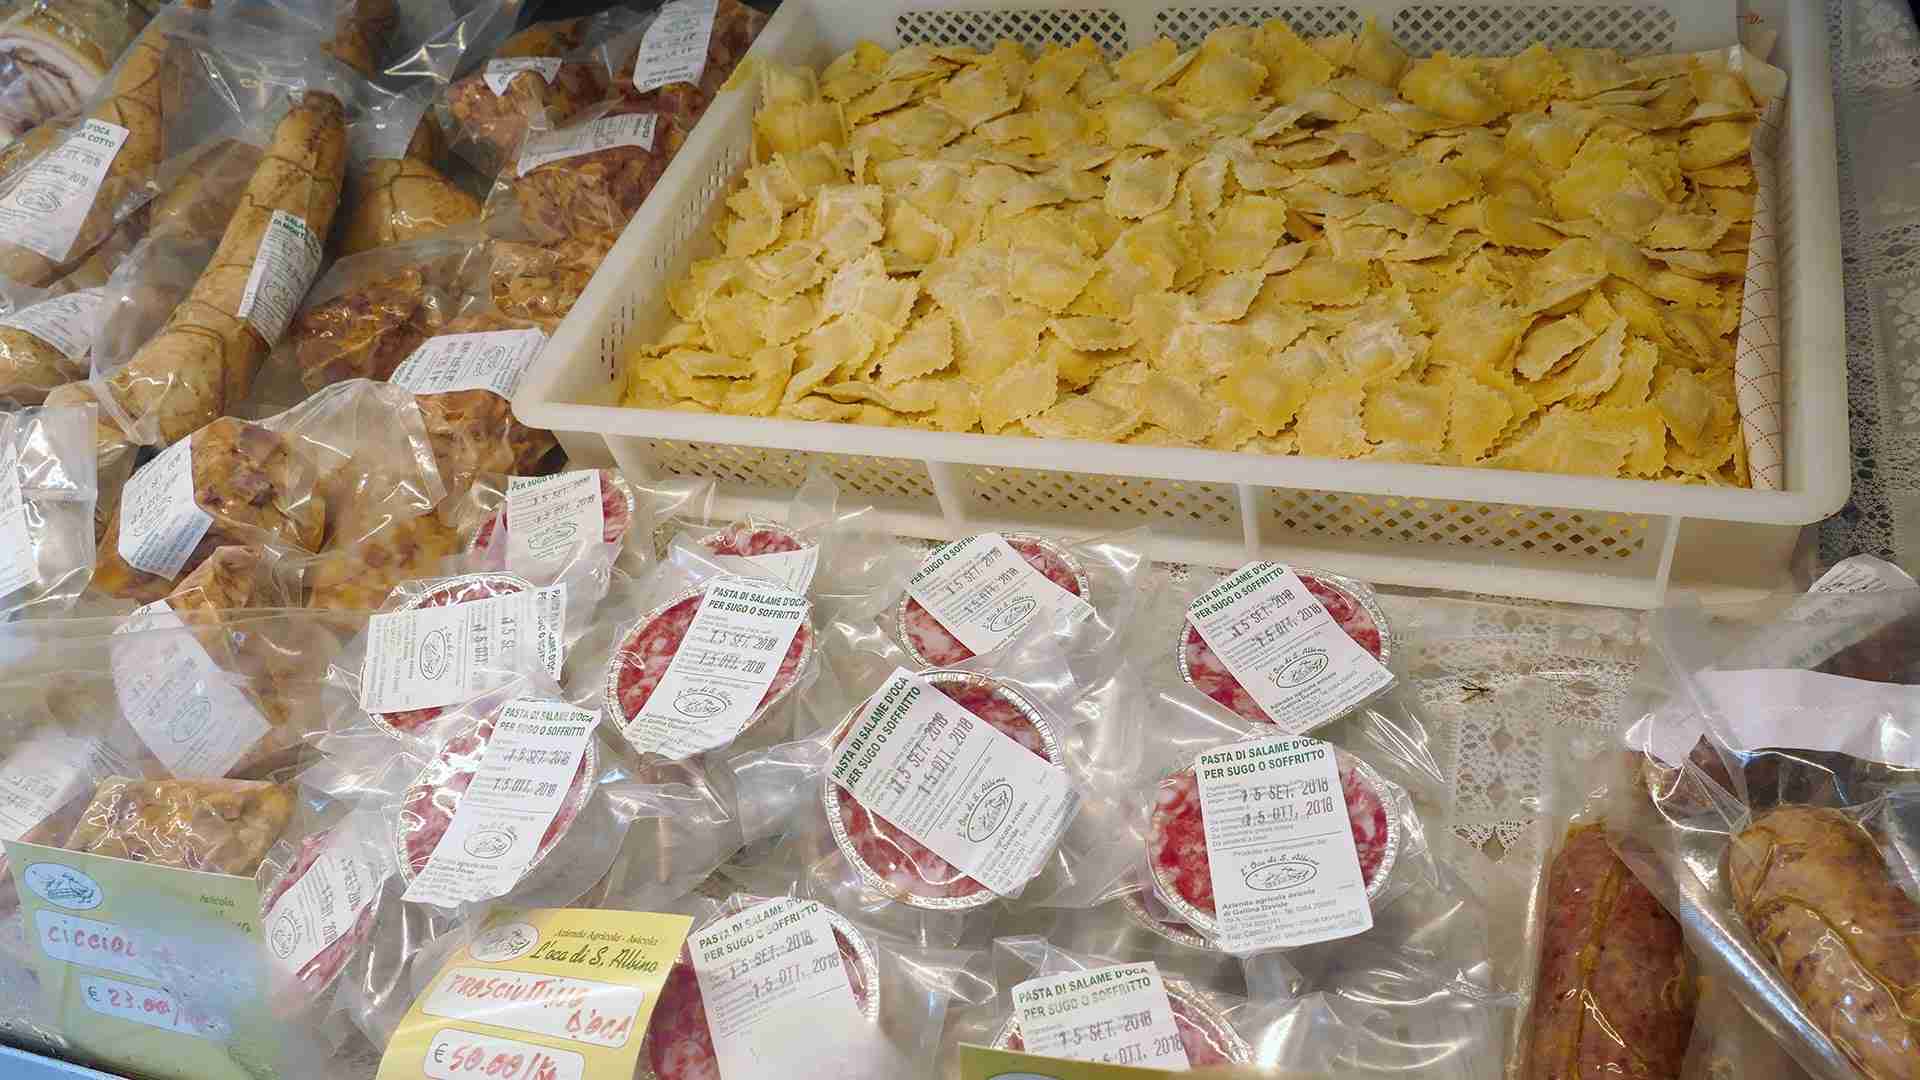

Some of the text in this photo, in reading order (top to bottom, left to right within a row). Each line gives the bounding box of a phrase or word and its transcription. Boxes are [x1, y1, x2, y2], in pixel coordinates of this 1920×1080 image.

[923, 559, 944, 577] SUGO
[943, 553, 951, 562] O
[713, 587, 739, 600] PASTA
[740, 592, 750, 601] DI
[749, 593, 783, 607] SALAME
[1194, 567, 1285, 620] PER SUGO O SOFFRITTO
[1211, 587, 1222, 598] DI
[1220, 570, 1254, 594] SALAME
[708, 600, 801, 621] PER SUGO O SOFFRITTO
[1271, 588, 1296, 608] 2018
[1298, 602, 1324, 621] 2018
[753, 637, 778, 651] 2018
[741, 659, 766, 674] 2018
[505, 707, 529, 720] PASTA
[924, 711, 950, 742] 2018
[539, 727, 546, 736] O
[545, 726, 587, 737] SOFFRITTO
[832, 677, 909, 780] PASTA DI SALAME D'OCA
[845, 685, 921, 789] PER SUGO O SOFFRITTO
[949, 716, 974, 748] 2018
[1201, 738, 1324, 766] PASTA DI SALAME D'OCA
[1203, 748, 1325, 780] PER SUGO O SOFFRITTO
[535, 782, 559, 797] 2018
[1268, 785, 1295, 801] SET.
[1301, 776, 1330, 796] 2018
[1272, 804, 1299, 821] OTT.
[1305, 796, 1334, 817] 2018
[699, 928, 731, 949] PASTA
[733, 922, 744, 936] DI
[704, 948, 725, 963] PER
[727, 934, 754, 954] SUGO
[754, 947, 780, 967] SET.
[786, 929, 814, 951] 2018
[572, 945, 587, 963] di
[588, 945, 606, 967] S.
[608, 945, 659, 973] Albino
[813, 952, 840, 975] 2018
[1018, 987, 1052, 1004] PASTA
[1055, 983, 1067, 995] DI
[1070, 971, 1113, 990] SALAME
[1023, 1005, 1047, 1021] PER
[1049, 997, 1078, 1016] SUGO
[1092, 976, 1152, 1002] SOFFRITTO
[1089, 1018, 1118, 1040] SET.
[1123, 1010, 1153, 1033] 2018
[434, 1042, 449, 1063] €
[1118, 1032, 1184, 1064] OTT. 2018
